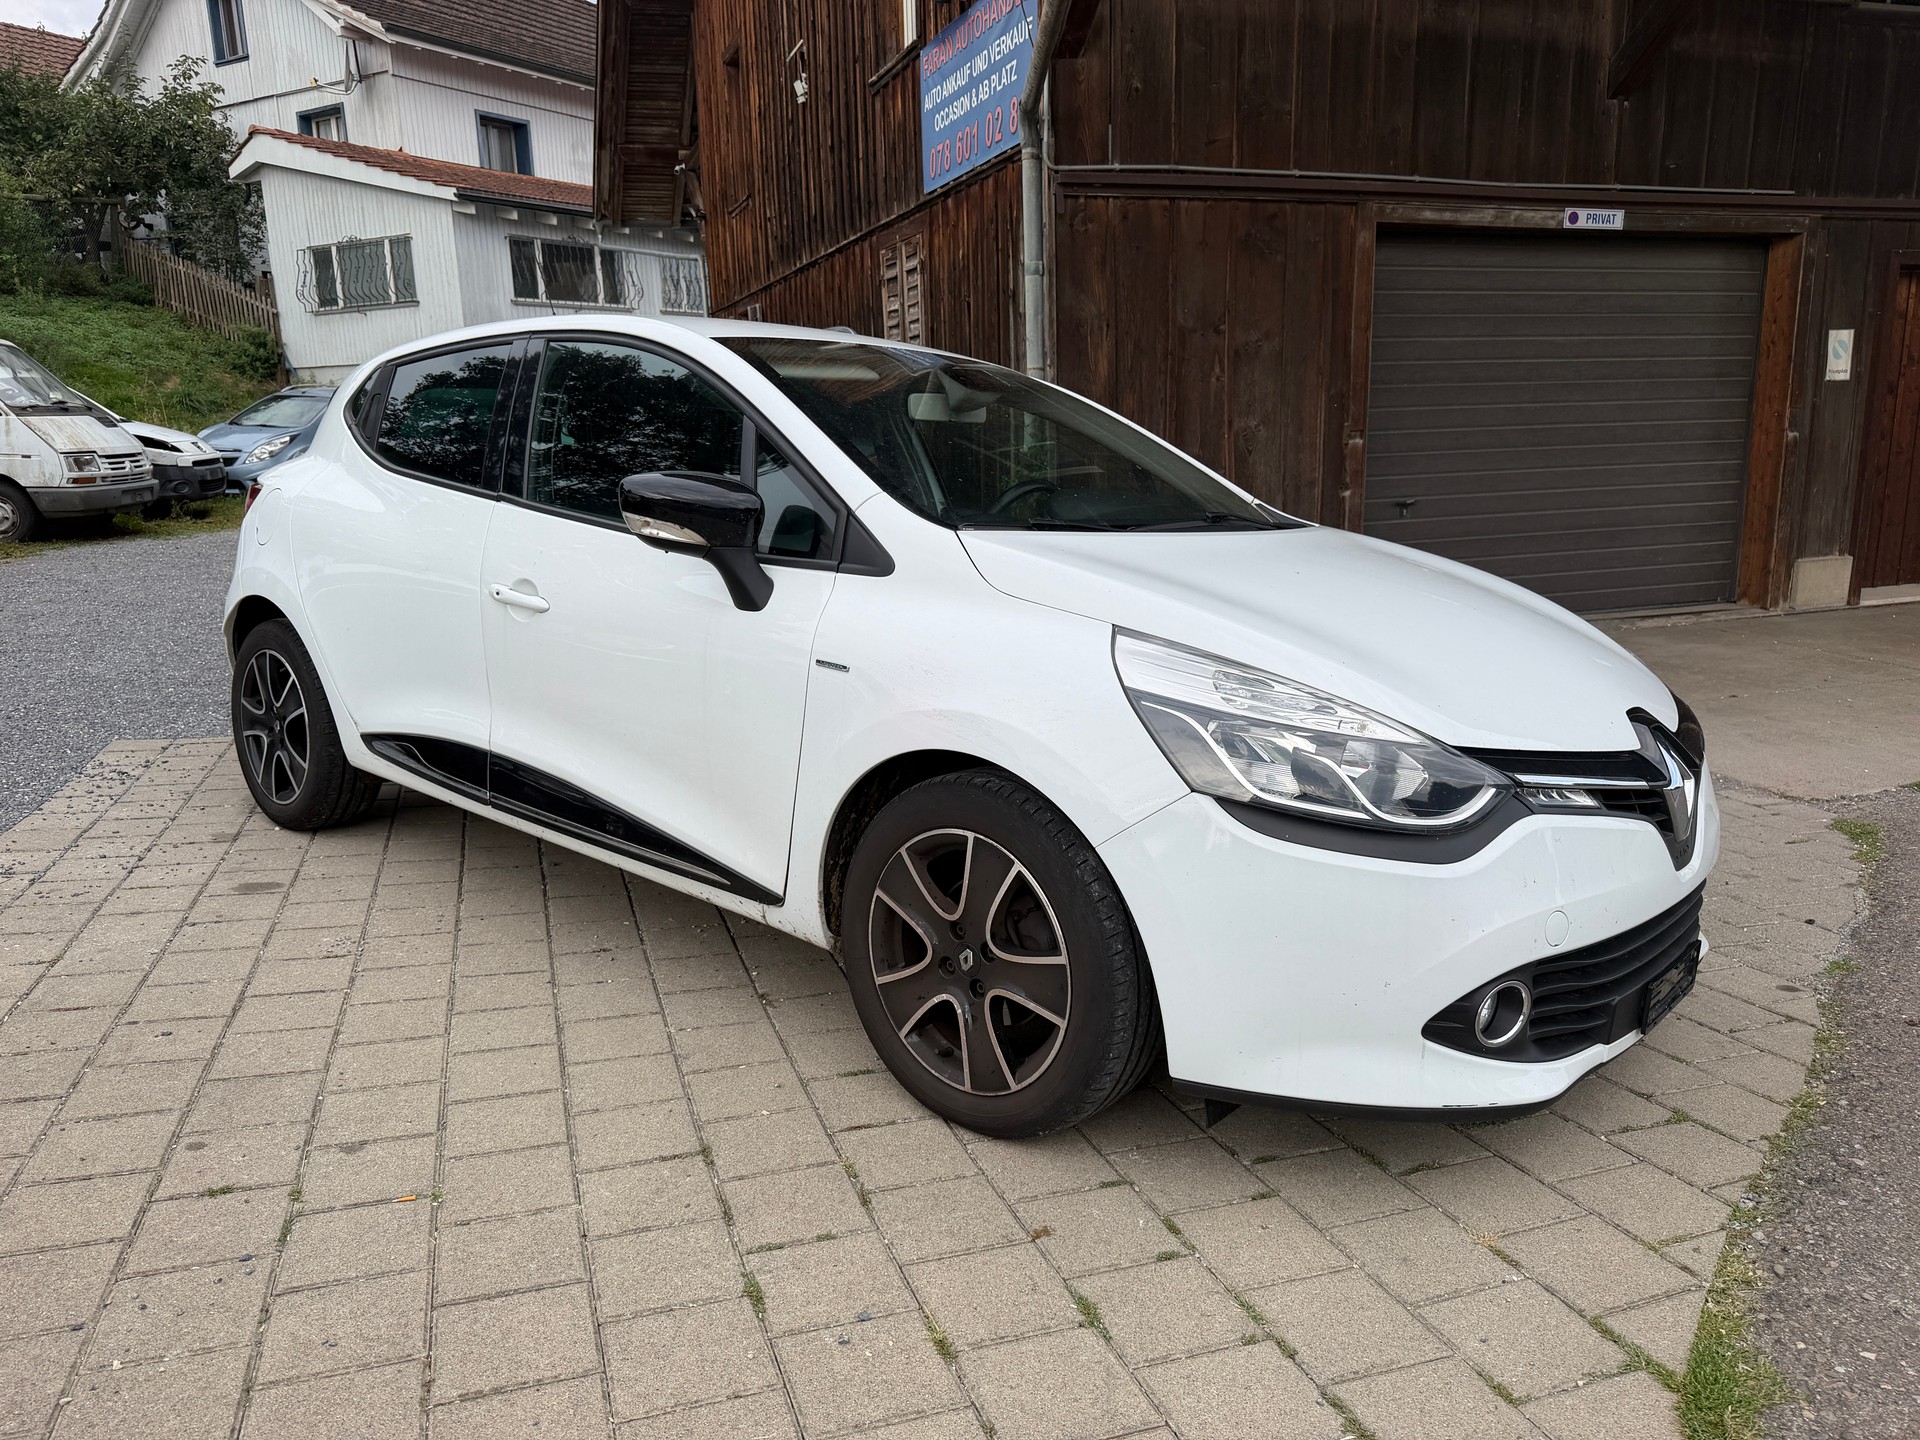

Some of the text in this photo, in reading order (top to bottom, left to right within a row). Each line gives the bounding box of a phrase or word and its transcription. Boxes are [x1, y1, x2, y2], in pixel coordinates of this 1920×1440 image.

[923, 37, 953, 80] FARAN
[924, 16, 1034, 112] AUTO ANKAUF UND VERKAUF
[934, 59, 1018, 131] OCCASION & AB PLATZ
[929, 96, 1020, 179] 078 601 02 8
[1585, 213, 1617, 225] PRIVAT
